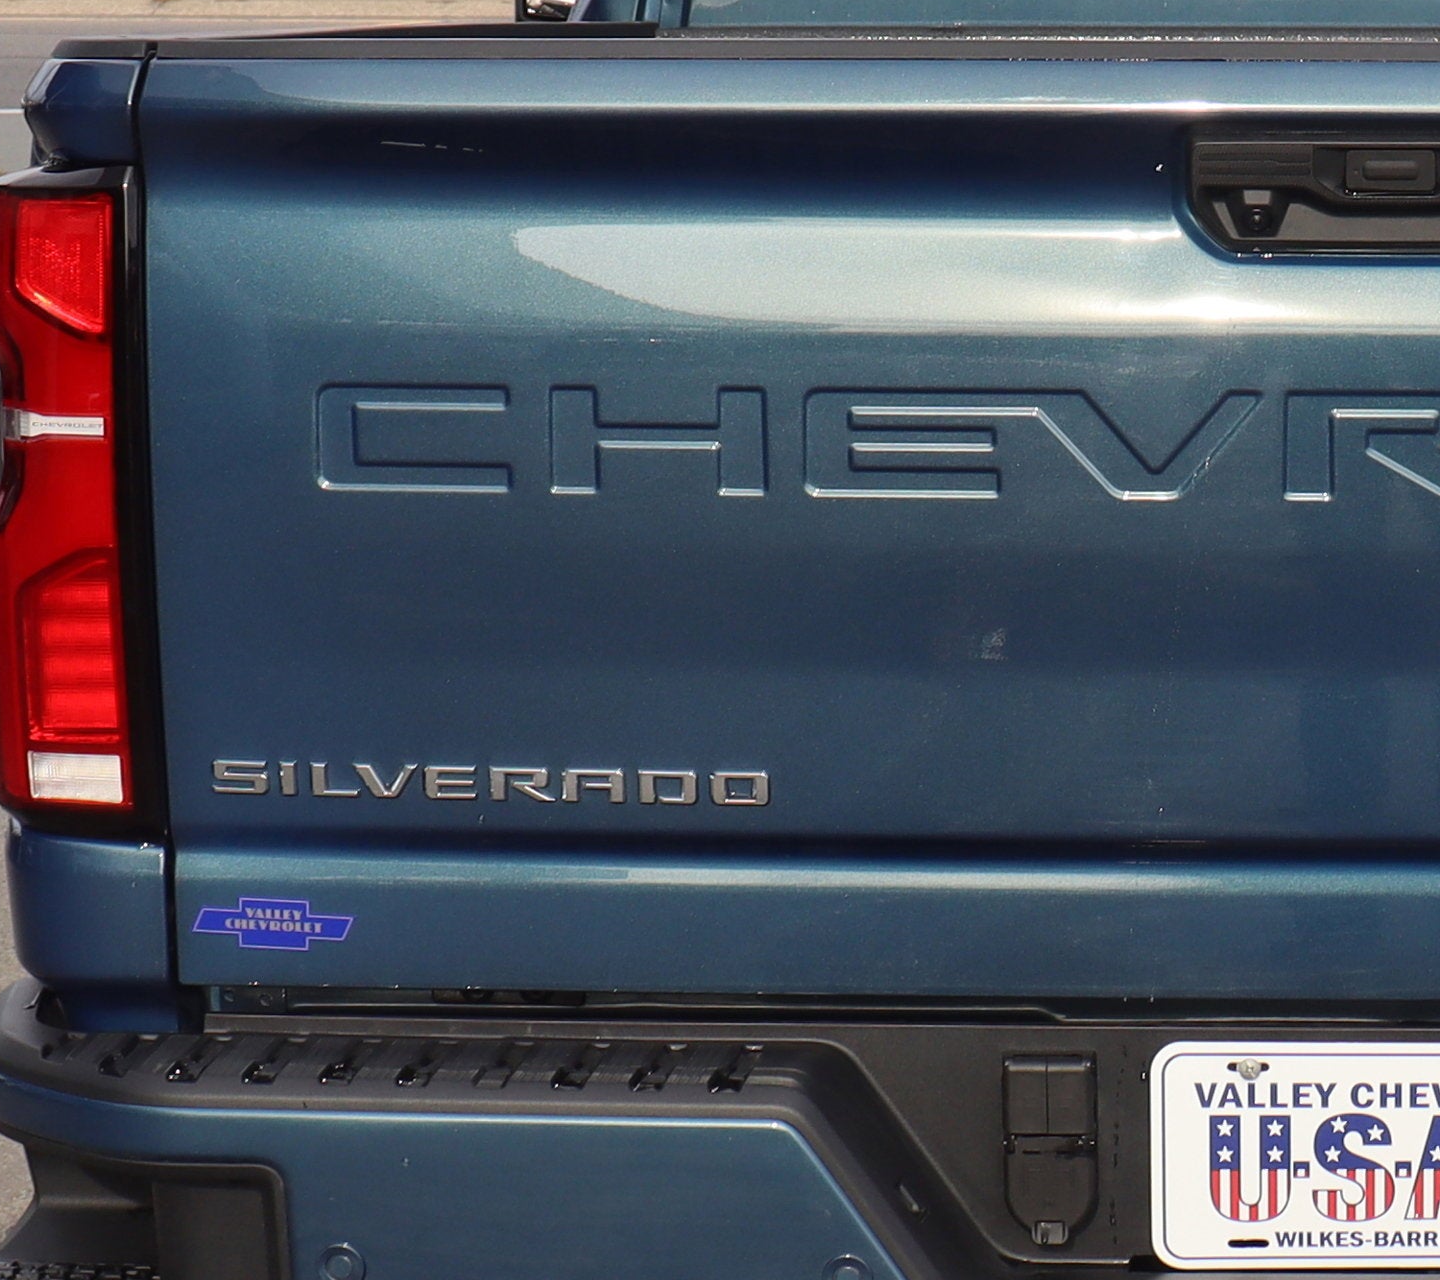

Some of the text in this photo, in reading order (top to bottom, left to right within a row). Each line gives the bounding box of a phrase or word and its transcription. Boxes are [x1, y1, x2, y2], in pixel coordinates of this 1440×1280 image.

[31, 421, 103, 429] CHEVROLET
[211, 758, 771, 806] SILVERADO
[244, 907, 303, 921] VALLEY
[224, 918, 323, 934] CHEVROLET
[1194, 1082, 1337, 1109] VALLEY
